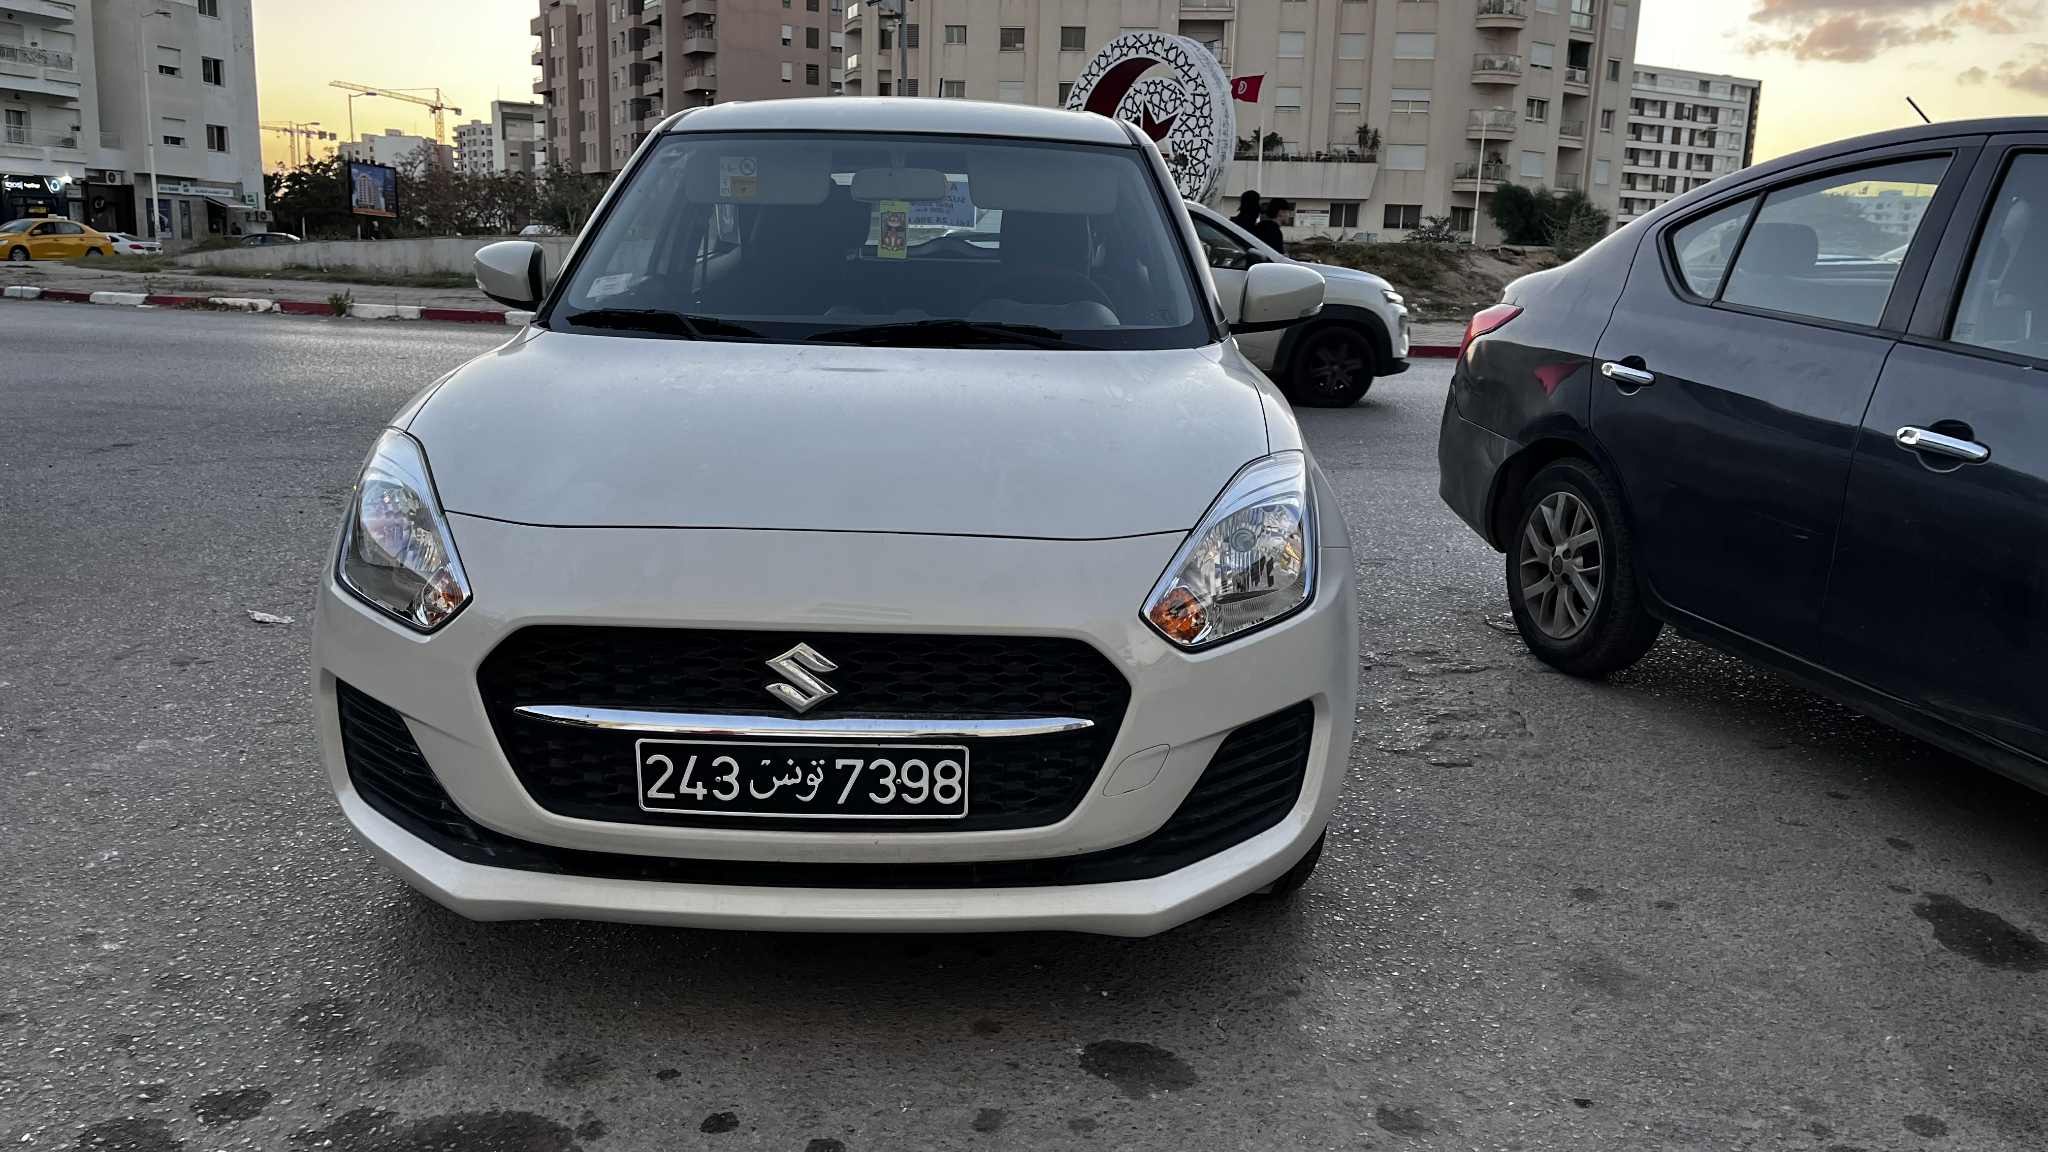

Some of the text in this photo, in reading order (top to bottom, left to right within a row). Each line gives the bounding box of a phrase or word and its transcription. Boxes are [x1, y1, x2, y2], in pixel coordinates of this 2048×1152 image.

[645, 754, 963, 805] 243 تونس 7398
